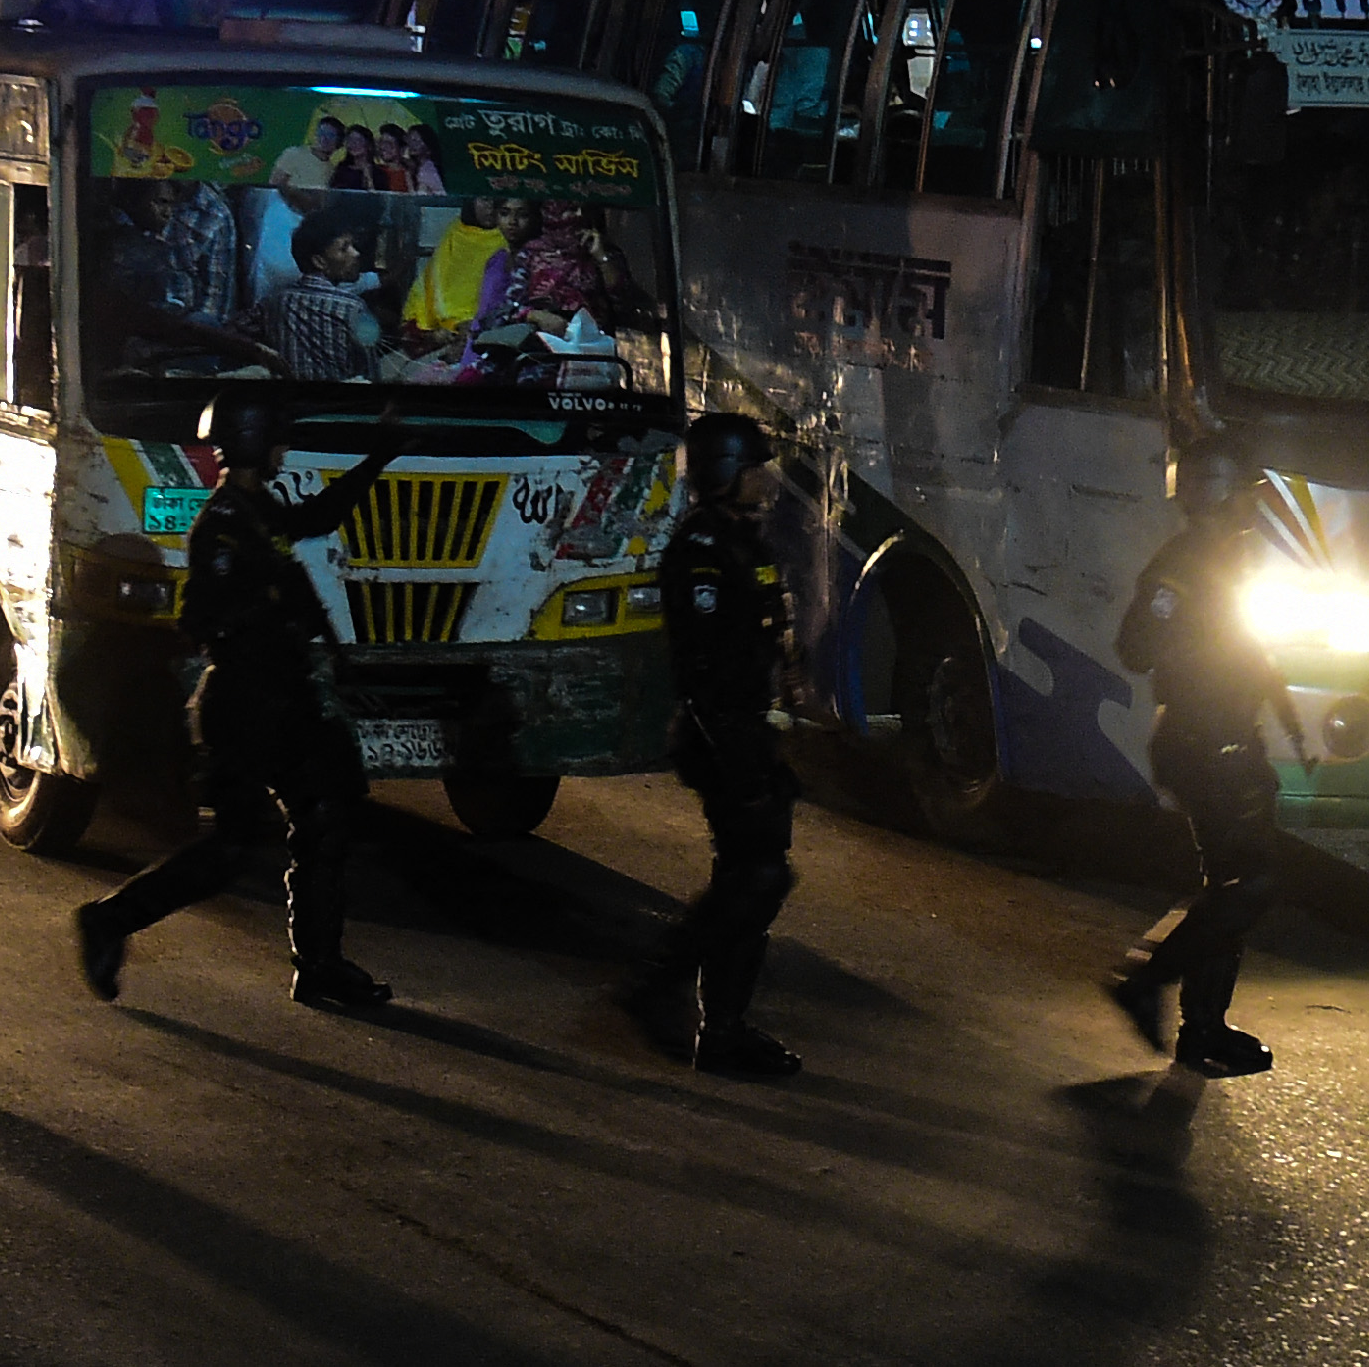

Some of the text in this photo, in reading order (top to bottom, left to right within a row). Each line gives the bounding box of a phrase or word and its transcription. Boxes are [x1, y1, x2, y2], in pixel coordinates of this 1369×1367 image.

[184, 112, 263, 151] Tango
[478, 109, 555, 141] তুরাগ
[467, 142, 640, 179] সিটিং সার্ভিস
[548, 397, 607, 412] VOLVO
